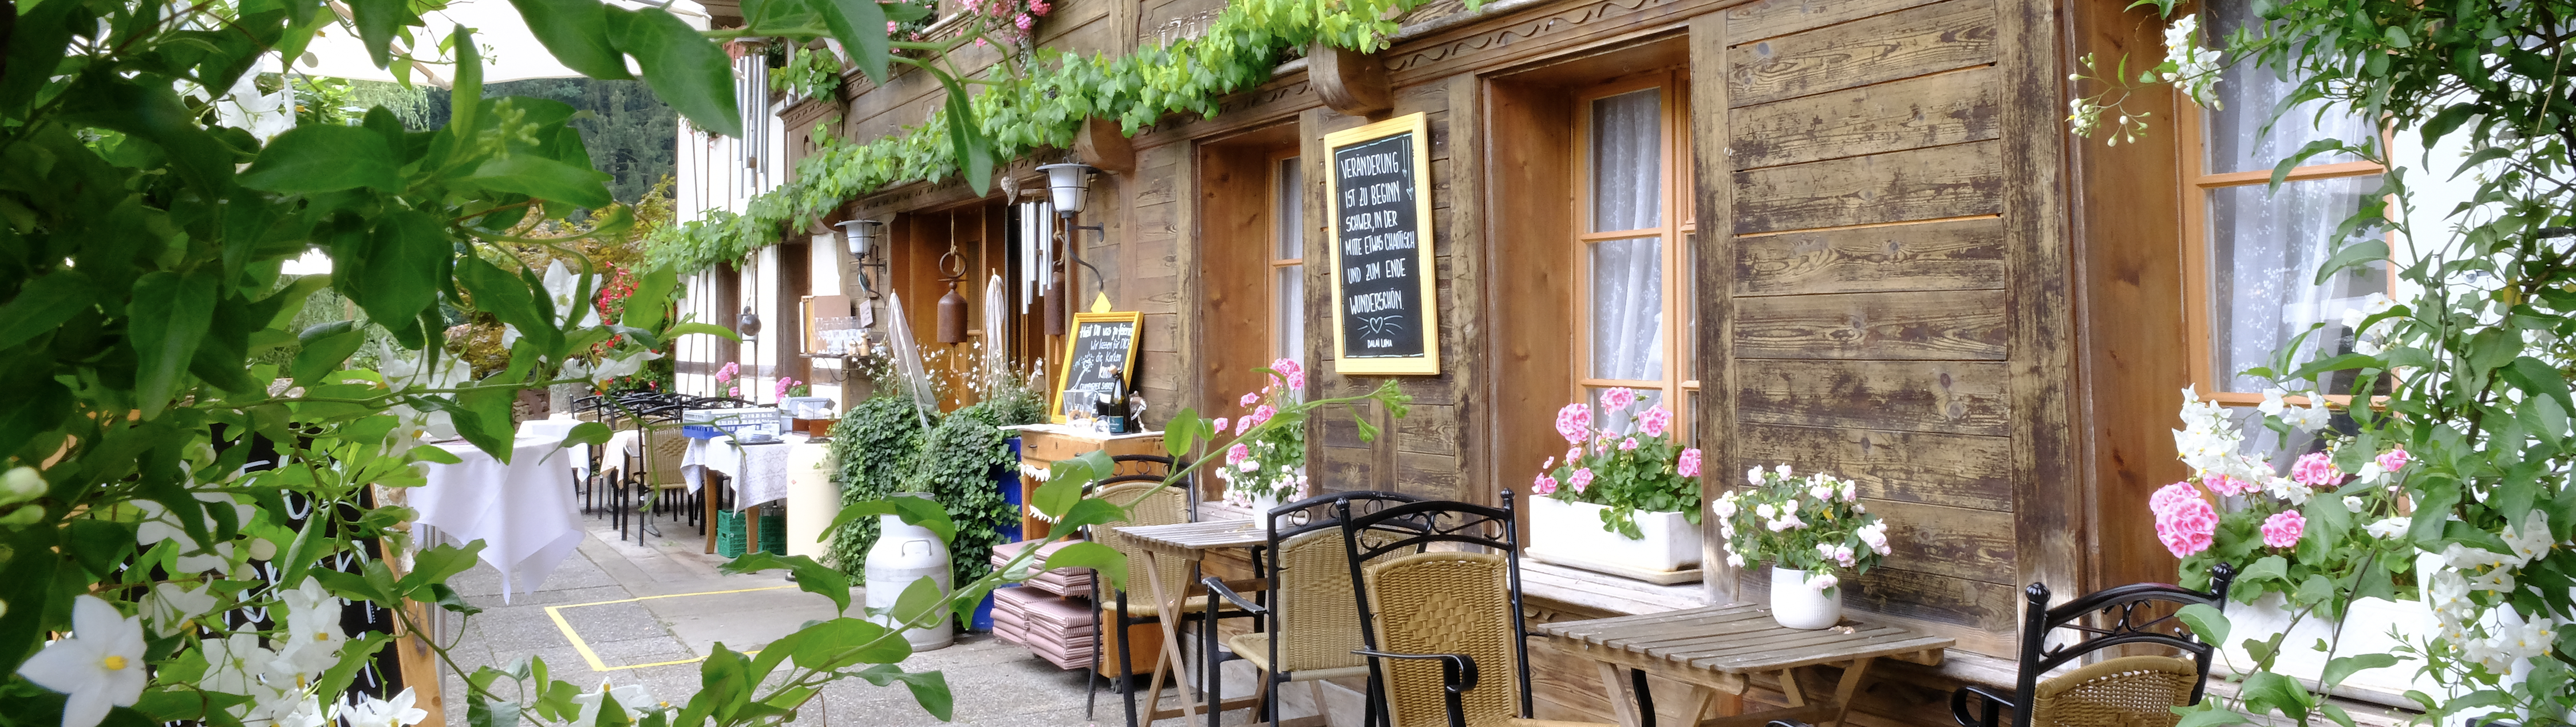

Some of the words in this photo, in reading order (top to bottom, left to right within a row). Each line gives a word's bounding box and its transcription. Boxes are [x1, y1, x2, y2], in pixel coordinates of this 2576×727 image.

[1341, 152, 1398, 179] VERÄNDERUNG
[1345, 189, 1355, 209] IST
[1360, 187, 1368, 207] ZU
[1371, 180, 1400, 206] BEGINN
[1374, 211, 1382, 228] IN
[1384, 210, 1398, 228] DER
[1345, 238, 1362, 255] MITTE
[1365, 235, 1384, 255] ETWAS
[1384, 230, 1415, 251] CHAOTISCH
[1347, 267, 1361, 284] UND
[1366, 262, 1380, 281] ZUM
[1385, 258, 1406, 278] ENDE
[1349, 287, 1404, 315] WUNDERSCHÖN.
